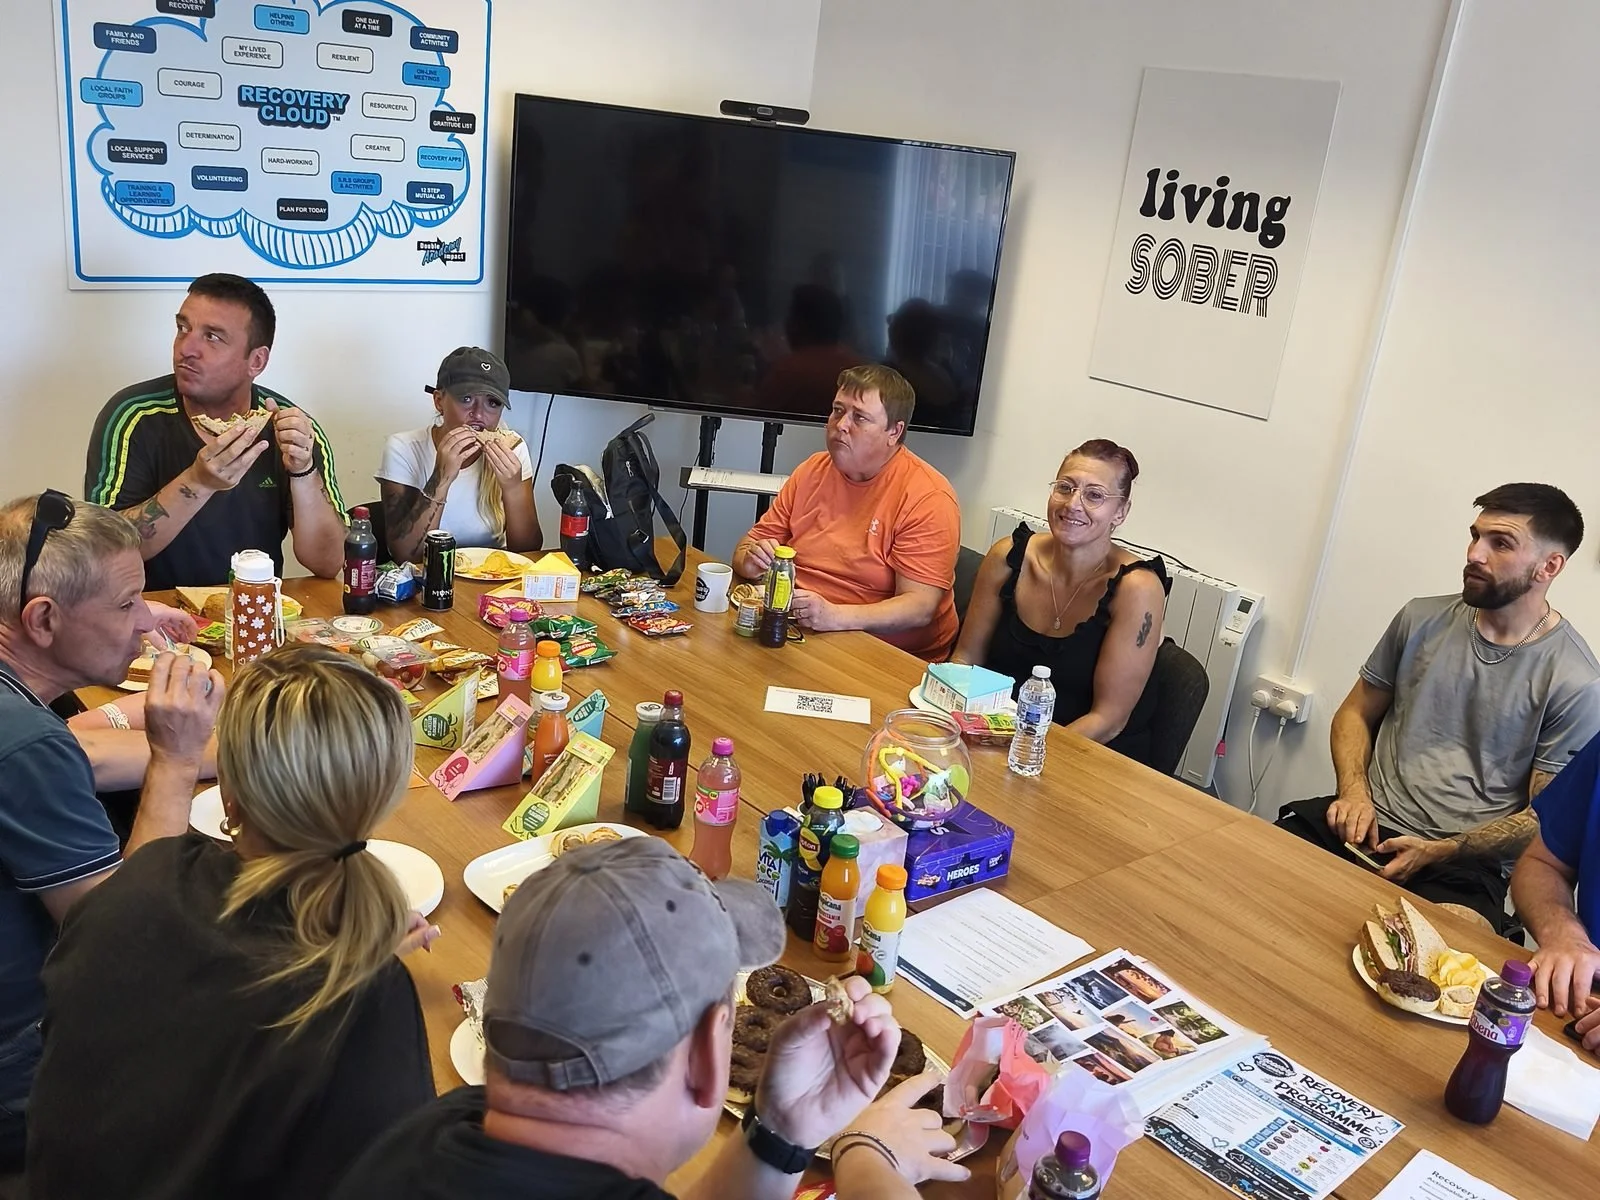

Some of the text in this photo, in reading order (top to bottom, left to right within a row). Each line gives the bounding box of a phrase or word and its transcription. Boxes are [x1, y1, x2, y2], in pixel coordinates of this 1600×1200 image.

[169, 2, 204, 11] RECOVERY
[269, 12, 295, 21] HELPING
[368, 17, 380, 25] DAY
[270, 18, 294, 27] OTHERS
[368, 24, 381, 32] TIME
[105, 30, 145, 40] FAMILY AND
[419, 32, 451, 41] COMMUNITY
[111, 37, 140, 46] FRIENDS
[420, 38, 449, 48] ACTIVITIES
[239, 44, 267, 53] MY LIVED
[234, 51, 272, 60] EXPERIENCE
[331, 53, 360, 62] RESILIENT
[416, 68, 438, 76] ON-LINE
[414, 74, 440, 83] MEETINGS
[173, 80, 206, 89] COURAGE
[90, 85, 133, 95] LOCAL FAITH
[97, 91, 127, 101] GROUPS
[240, 86, 349, 111] RECOVERY
[369, 102, 409, 112] RESOURCEFUL
[260, 105, 329, 125] CLOUD
[433, 120, 473, 130] GRATITUDE LIST
[185, 131, 235, 141] DETERMINATION
[110, 145, 133, 153] LOCAL
[365, 144, 391, 152] CREATIVE
[122, 152, 154, 160] SERVICES
[420, 154, 447, 162] RECOVERY
[267, 157, 313, 166] HARD-WORKING
[197, 174, 243, 183] VOLUNTEERING
[127, 184, 157, 192] TRAINING
[120, 197, 171, 205] OPPORTUNITIES
[298, 206, 307, 214] FOR
[308, 207, 327, 215] TODAY
[1139, 168, 1291, 249] living
[1125, 233, 1279, 318] SOBER
[759, 851, 777, 871] VITA
[946, 863, 980, 882] HEROES
[1300, 1074, 1383, 1120] RECOVERY
[1315, 1093, 1354, 1114] DAY
[1274, 1081, 1374, 1136] PROGRAMME
[1432, 1170, 1478, 1200] Recovery
